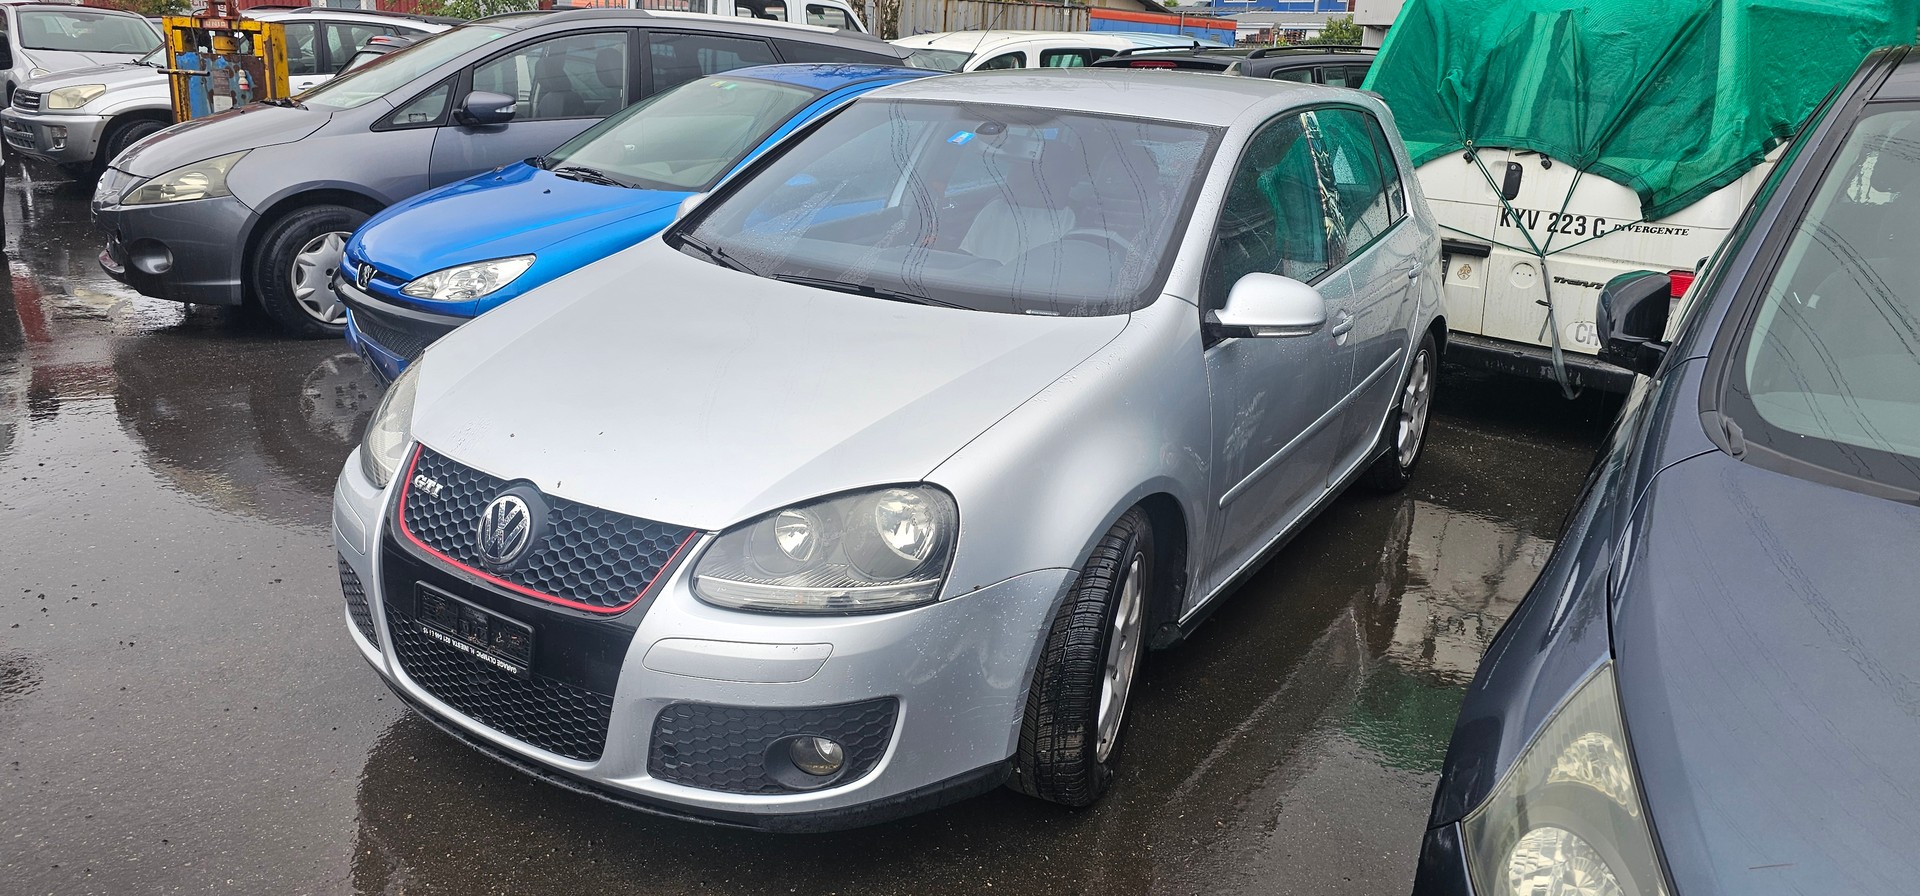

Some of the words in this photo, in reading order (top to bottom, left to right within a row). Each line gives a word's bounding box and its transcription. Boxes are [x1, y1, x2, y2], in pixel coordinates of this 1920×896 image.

[1500, 207, 1540, 231] KYV
[1547, 212, 1587, 238] 223
[1592, 217, 1606, 239] C
[1613, 223, 1690, 237] DIVERGENTE
[414, 474, 444, 498] GTI
[475, 650, 497, 665] OLYMPIC
[496, 661, 518, 674] GARAGE
